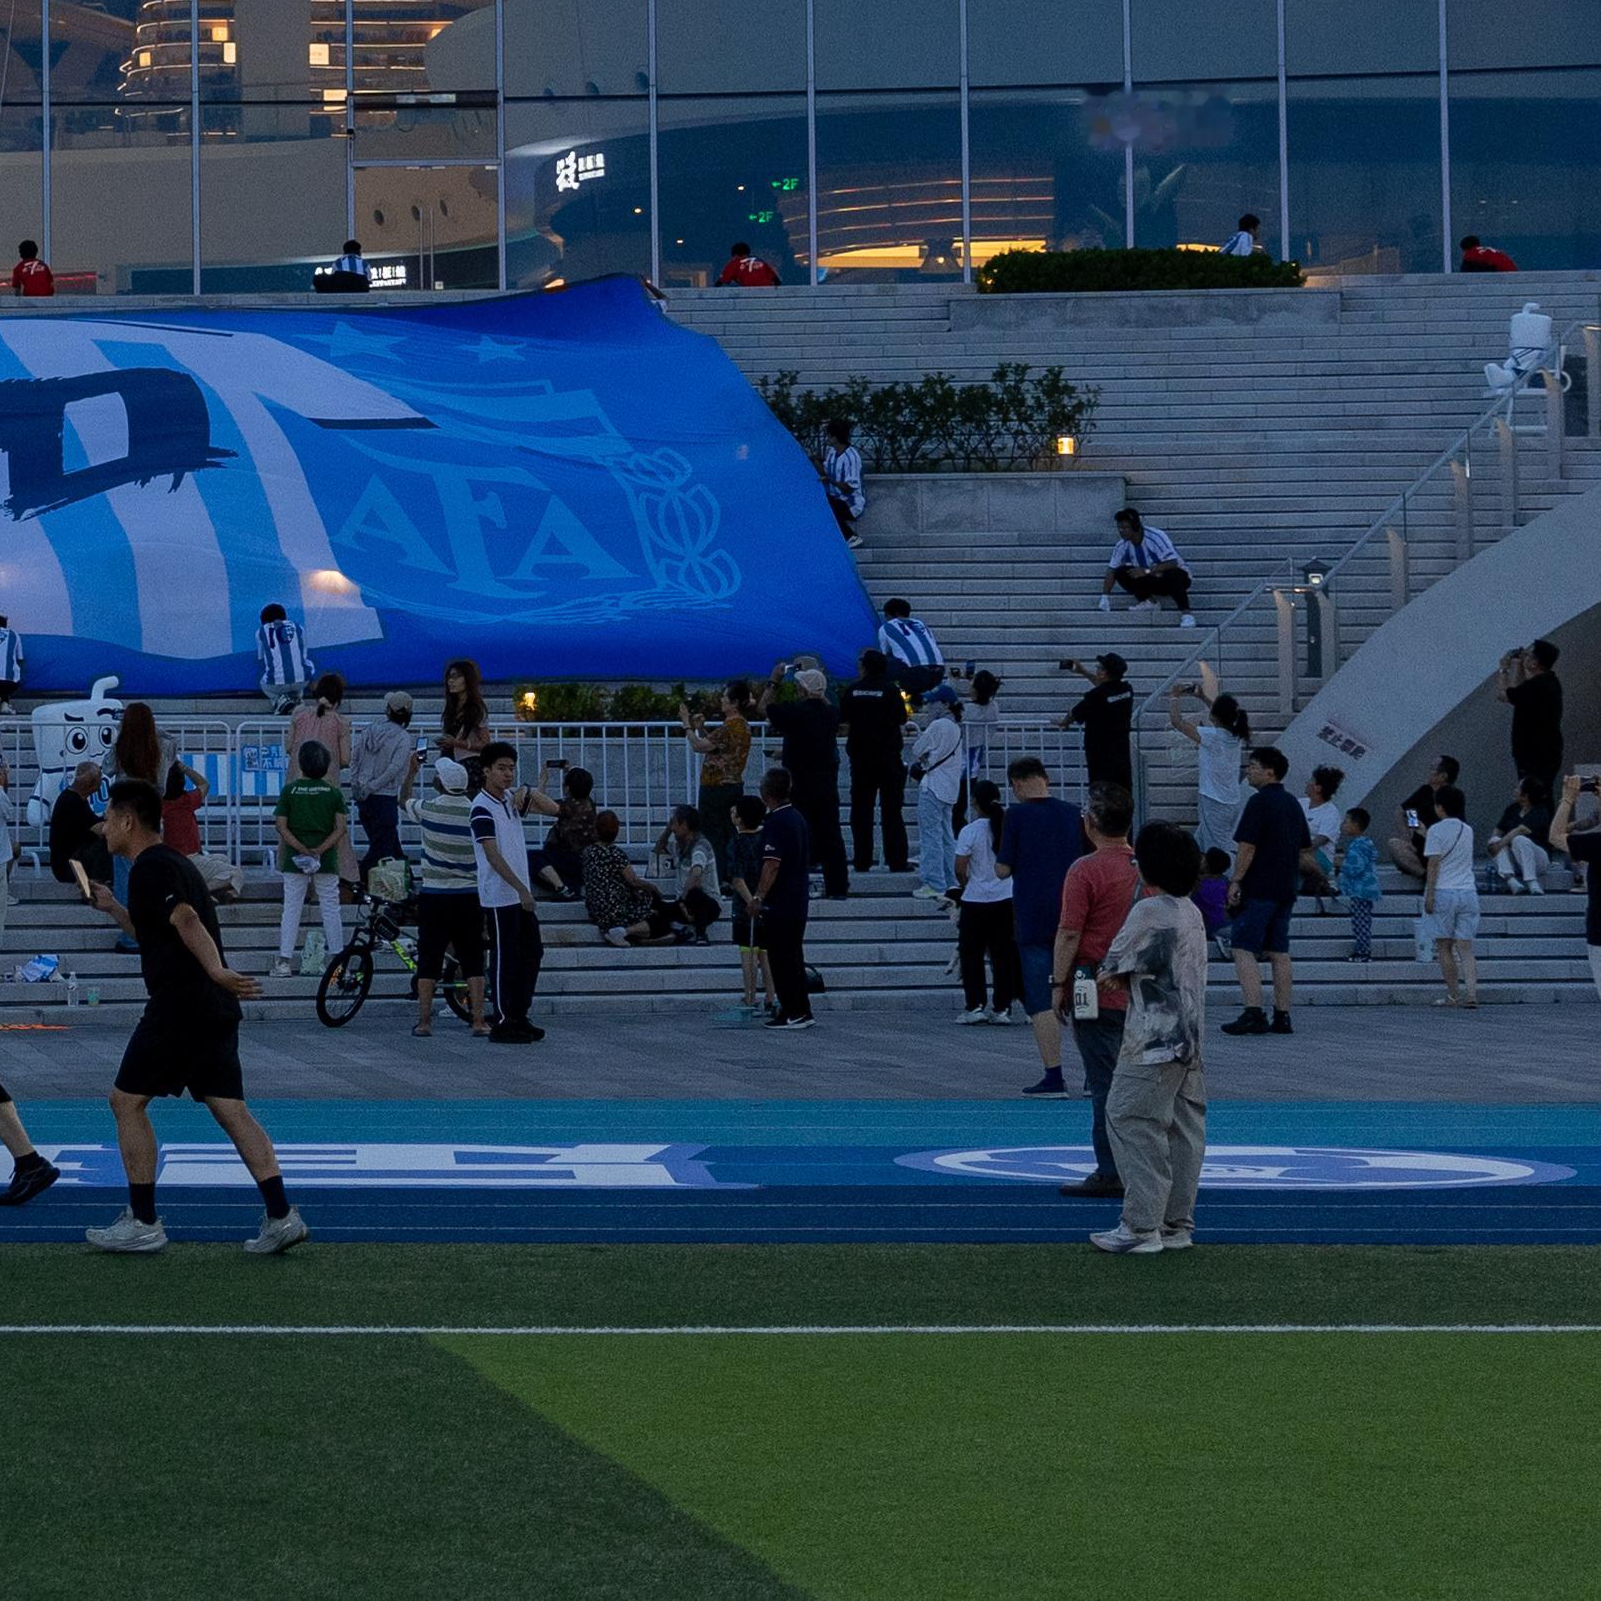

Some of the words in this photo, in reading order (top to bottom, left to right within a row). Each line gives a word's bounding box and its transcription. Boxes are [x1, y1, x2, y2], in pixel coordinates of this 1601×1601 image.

[782, 178, 799, 191] 2F
[758, 211, 774, 224] 2F
[335, 458, 633, 601] AFA
